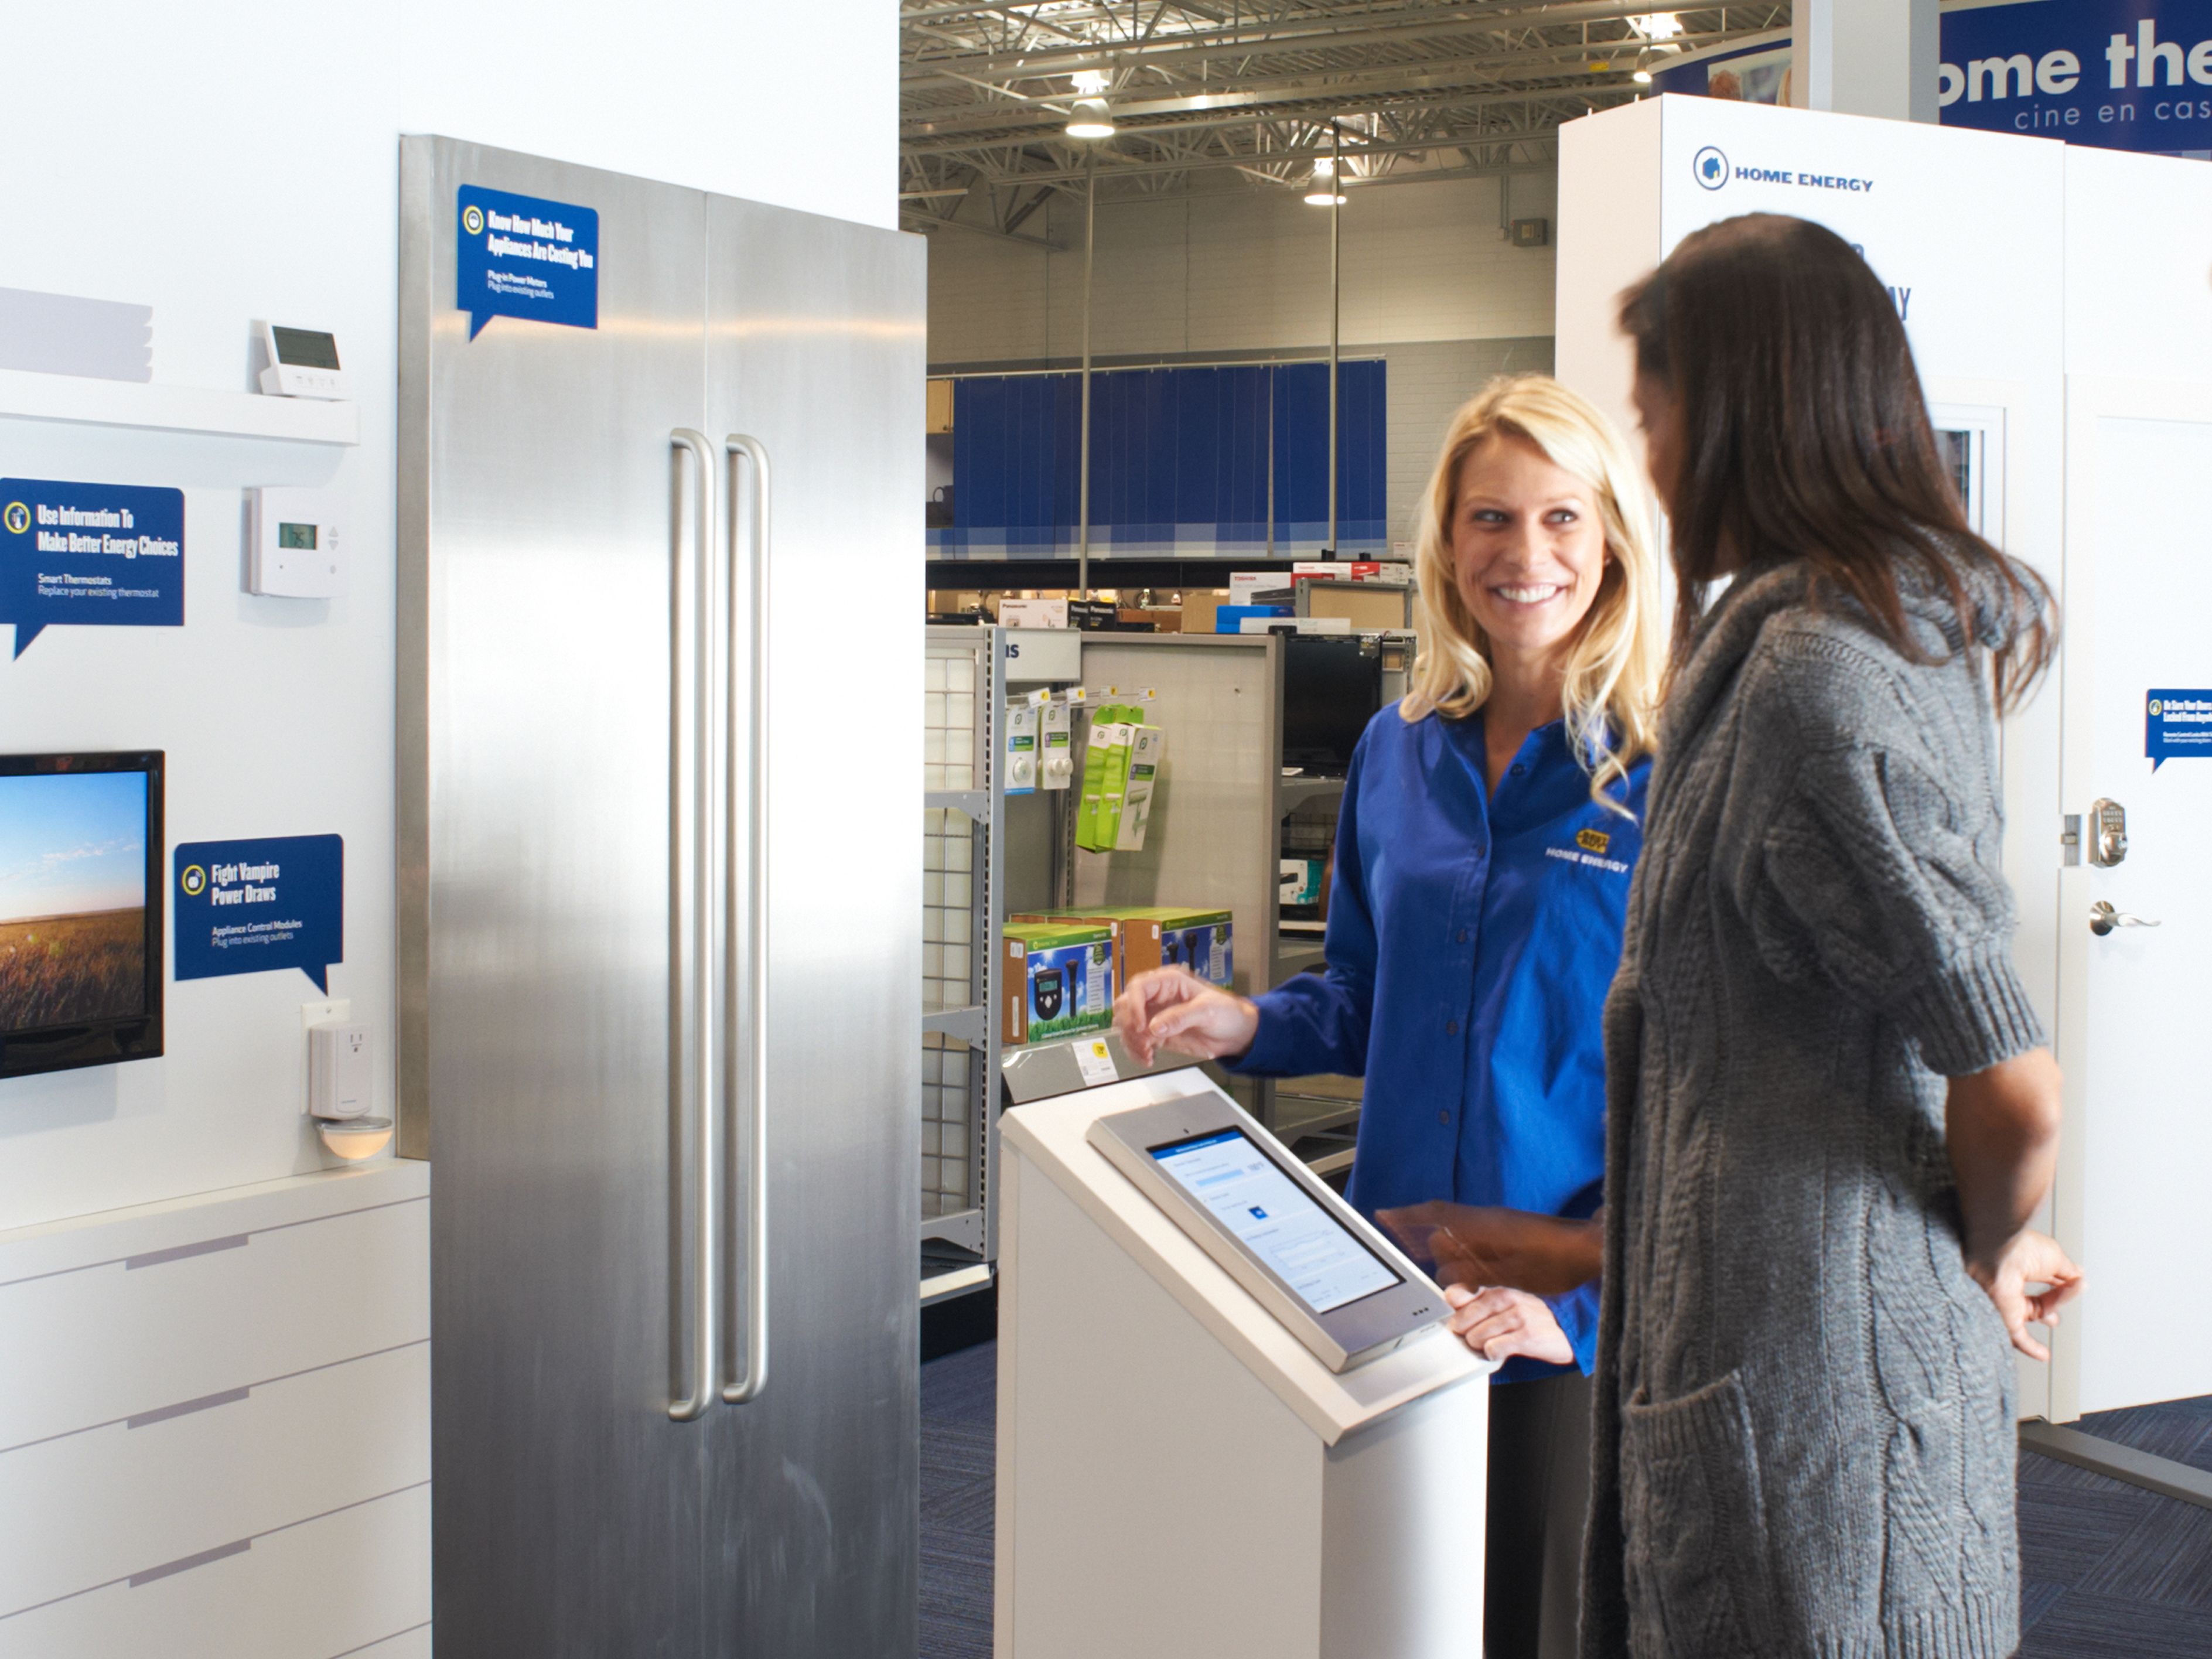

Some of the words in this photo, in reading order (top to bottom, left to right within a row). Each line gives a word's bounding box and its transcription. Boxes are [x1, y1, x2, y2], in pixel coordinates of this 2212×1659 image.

[2014, 104, 2081, 130] cine
[2097, 103, 2135, 122] en
[2154, 100, 2211, 120] cas
[1735, 166, 1793, 185] HOME
[1797, 173, 1874, 192] ENERGY
[488, 209, 512, 231] Know
[512, 214, 531, 234] How
[531, 217, 555, 239] Much
[555, 221, 574, 243] Your
[487, 233, 532, 258] Appliances
[532, 241, 547, 261] Are
[548, 243, 578, 269] Costing
[578, 248, 593, 269] You
[37, 504, 59, 525] Use
[59, 505, 120, 528] Information
[121, 508, 134, 529] To
[37, 531, 68, 552] Make
[68, 532, 102, 554] Better
[102, 534, 138, 559] Energy
[138, 535, 179, 557] Choices
[37, 573, 63, 584] Smart
[64, 574, 112, 586] Thermostats
[37, 585, 69, 598] Replace
[69, 589, 87, 598] your
[87, 588, 118, 599] existing
[118, 588, 159, 598] thermostat
[1545, 848, 1581, 862] HOME
[1581, 854, 1629, 873] ENERGY
[211, 863, 238, 886] Fight
[238, 861, 280, 883] Vampire
[211, 887, 244, 906] Power
[244, 884, 276, 903] Draws
[211, 925, 247, 937] Appliance
[247, 921, 272, 933] Control
[273, 919, 303, 930] Modules
[211, 937, 228, 948] Plug
[228, 936, 242, 945] into
[243, 934, 270, 944] existing
[270, 931, 294, 942] outlets
